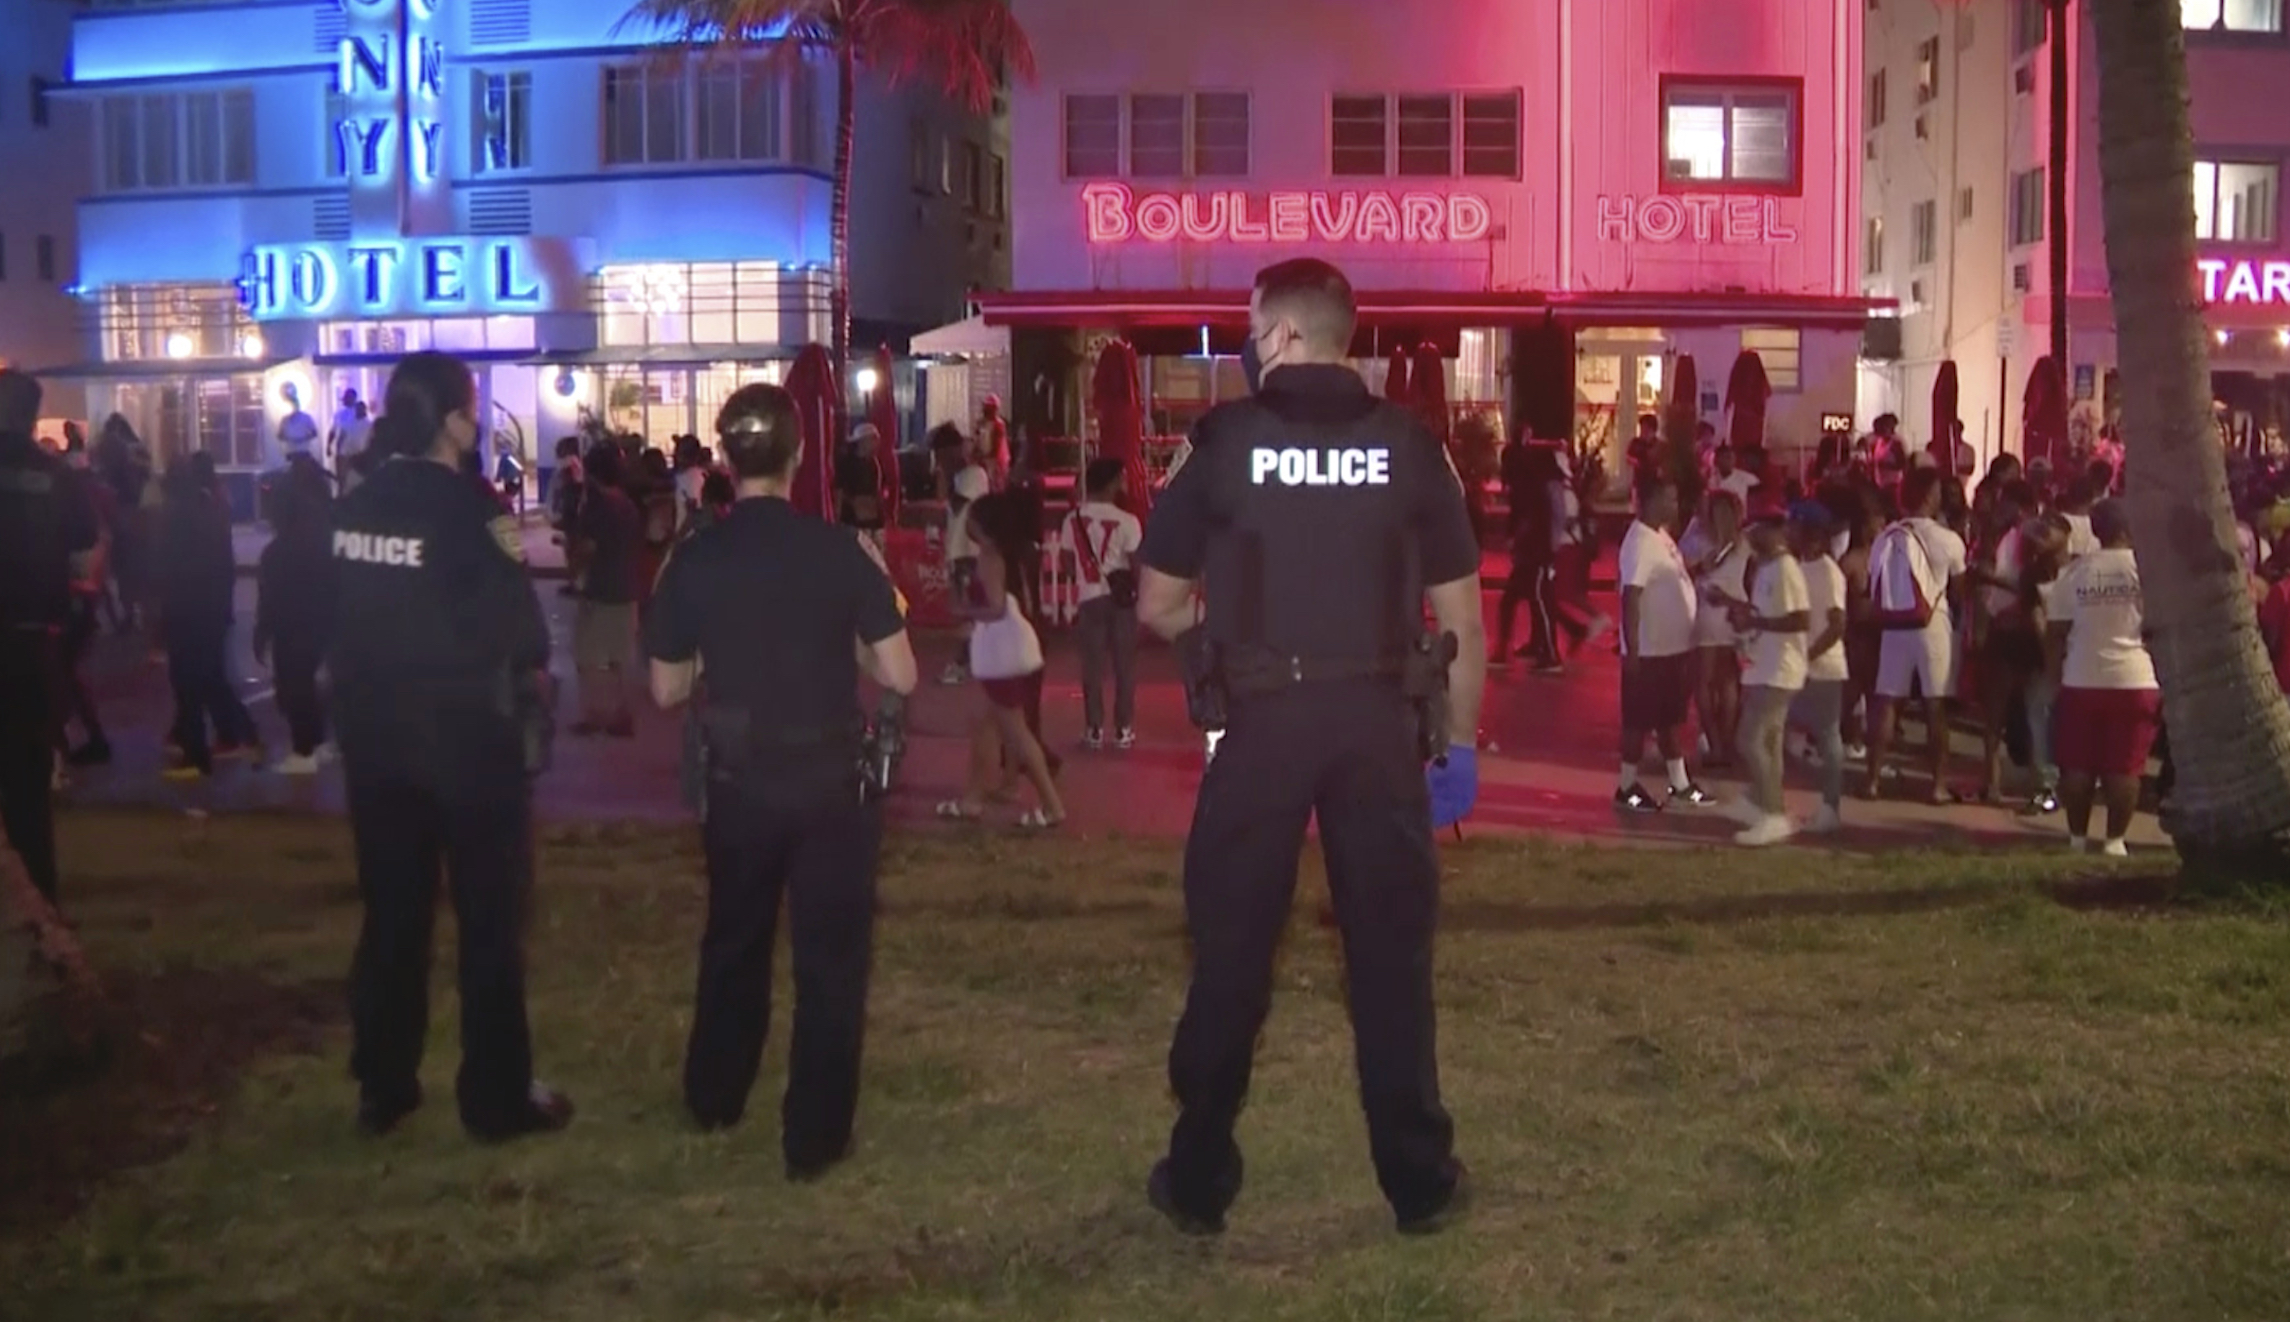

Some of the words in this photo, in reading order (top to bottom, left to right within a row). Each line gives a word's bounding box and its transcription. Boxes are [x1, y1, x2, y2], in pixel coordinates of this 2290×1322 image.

[1083, 183, 1491, 243] BOULEVARD
[1597, 194, 1797, 243] HOTEL
[236, 244, 540, 307] HOTEL
[1823, 416, 1850, 430] FDC
[1251, 448, 1390, 486] POLICE
[333, 530, 424, 568] POLICE
